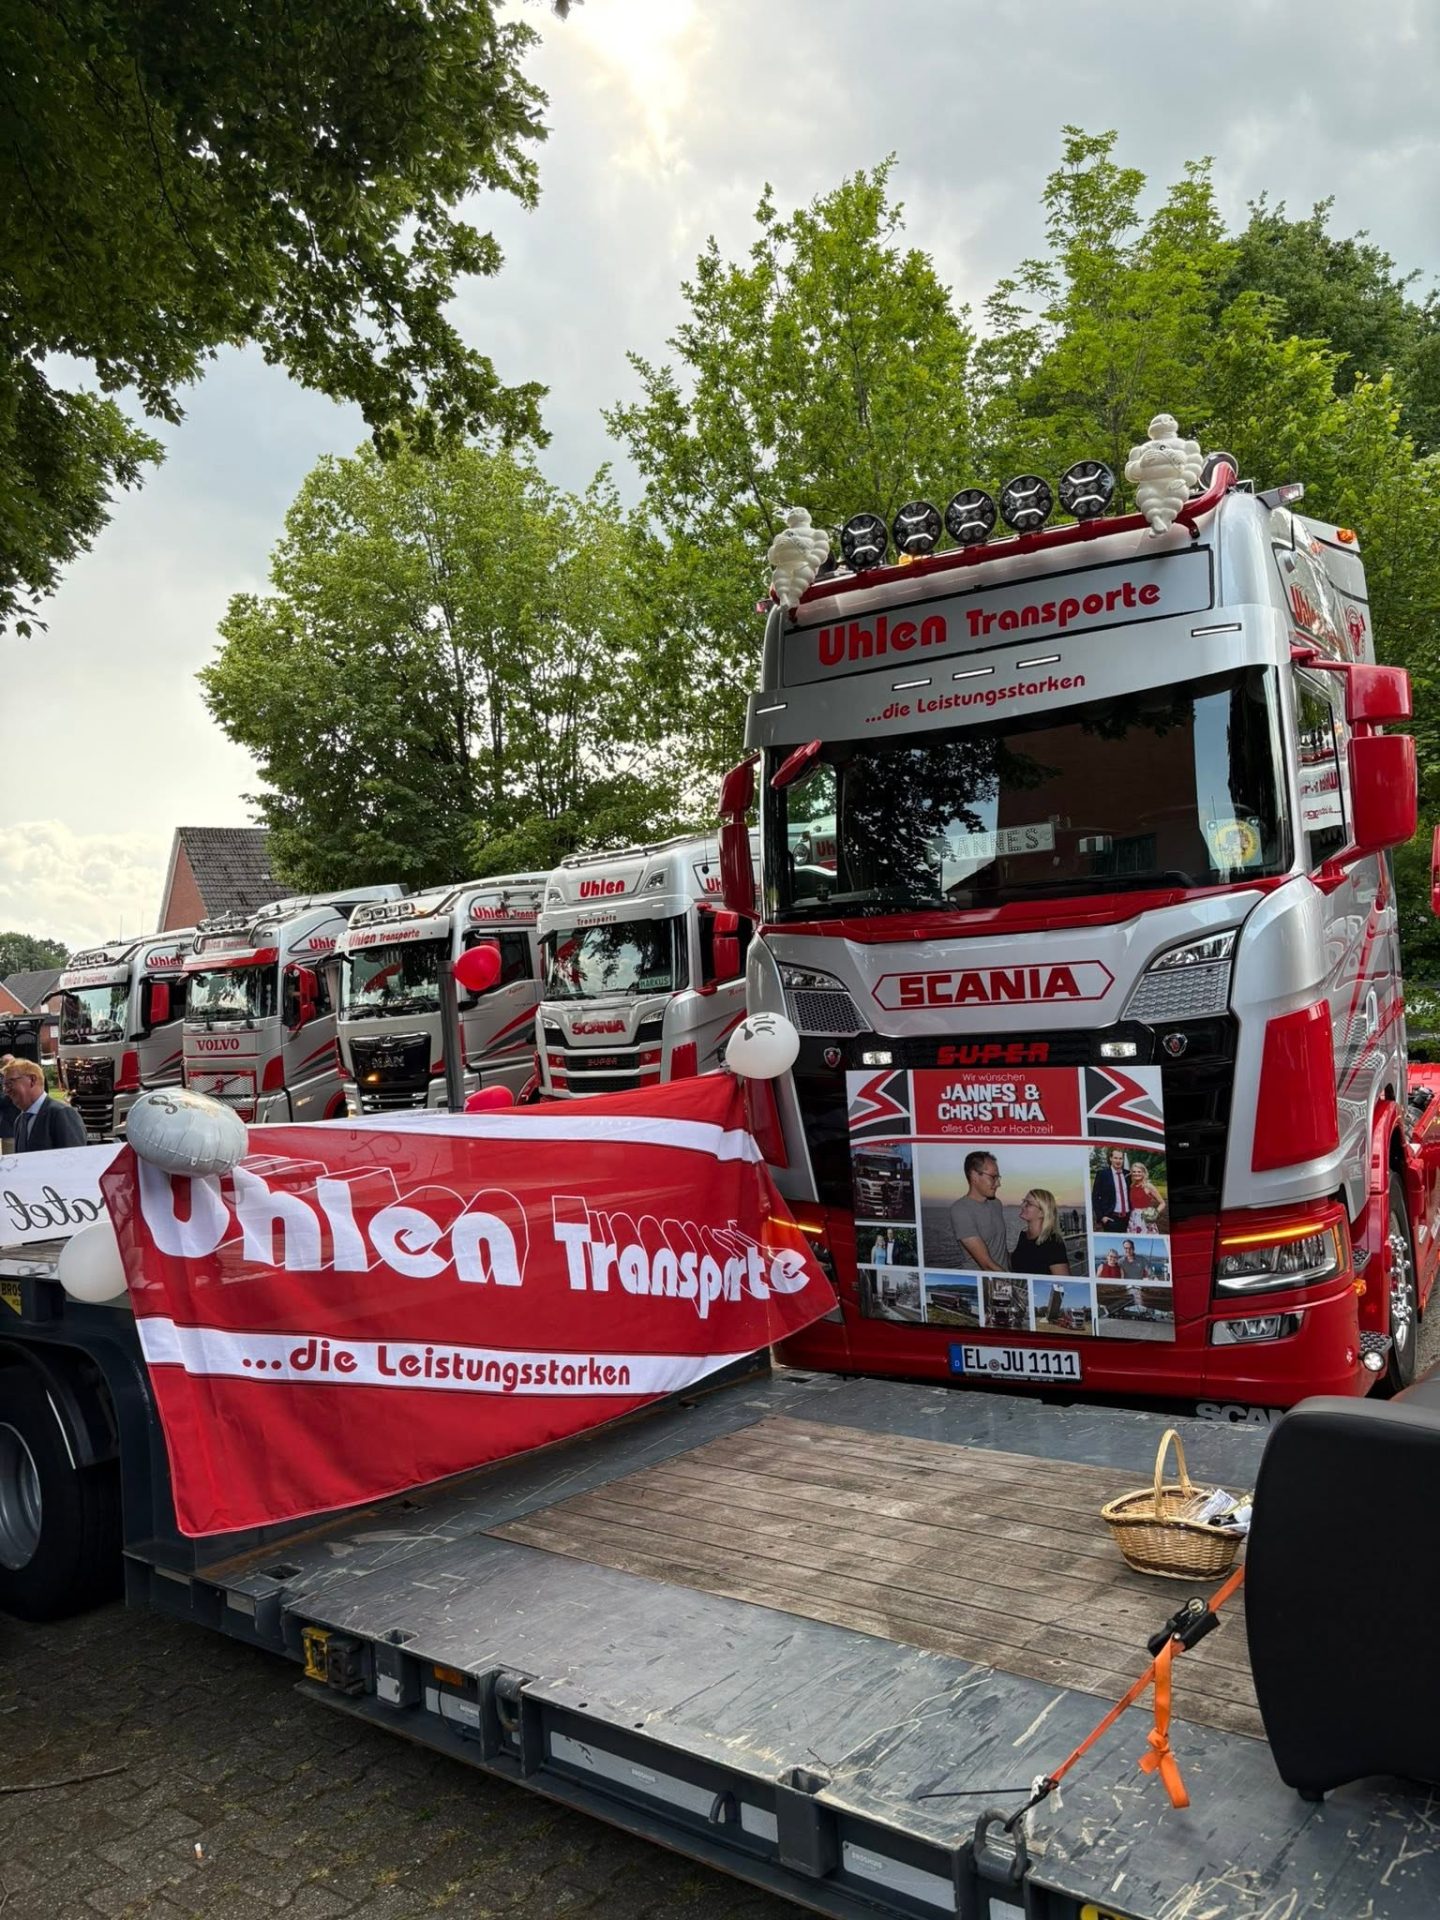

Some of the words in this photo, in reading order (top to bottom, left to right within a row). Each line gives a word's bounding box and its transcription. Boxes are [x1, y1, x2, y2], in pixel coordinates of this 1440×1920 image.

[818, 614, 947, 666] Uhlen
[966, 582, 1161, 627] Transporte
[865, 700, 911, 724] ...die
[917, 674, 1086, 715] Leistungsstarken
[580, 879, 625, 898] Uhlen
[577, 915, 617, 927] Transporte
[349, 932, 377, 948] Uhlen
[379, 928, 420, 943] Transporte
[900, 966, 1082, 1006] SCANIA
[572, 1019, 626, 1036] SCANIA
[196, 1037, 240, 1051] VOLVO
[937, 1042, 1050, 1066] SUPER
[371, 1055, 405, 1069] MAN
[962, 1073, 976, 1082] Wir
[979, 1073, 1026, 1082] wünschen
[940, 1083, 1017, 1103] JANNES
[1024, 1083, 1041, 1101] &
[938, 1101, 1046, 1122] CHRISTINA
[941, 1124, 963, 1134] alles
[965, 1124, 990, 1134] Gute
[993, 1125, 1007, 1134] zur
[1009, 1123, 1054, 1135] Hochzeit
[137, 1160, 524, 1287] Uhlen
[242, 1339, 358, 1374] ...die
[377, 1345, 631, 1392] Leistungsstarken
[964, 1348, 988, 1370] EL
[1001, 1350, 1024, 1372] JU
[1028, 1352, 1077, 1376] 1111
